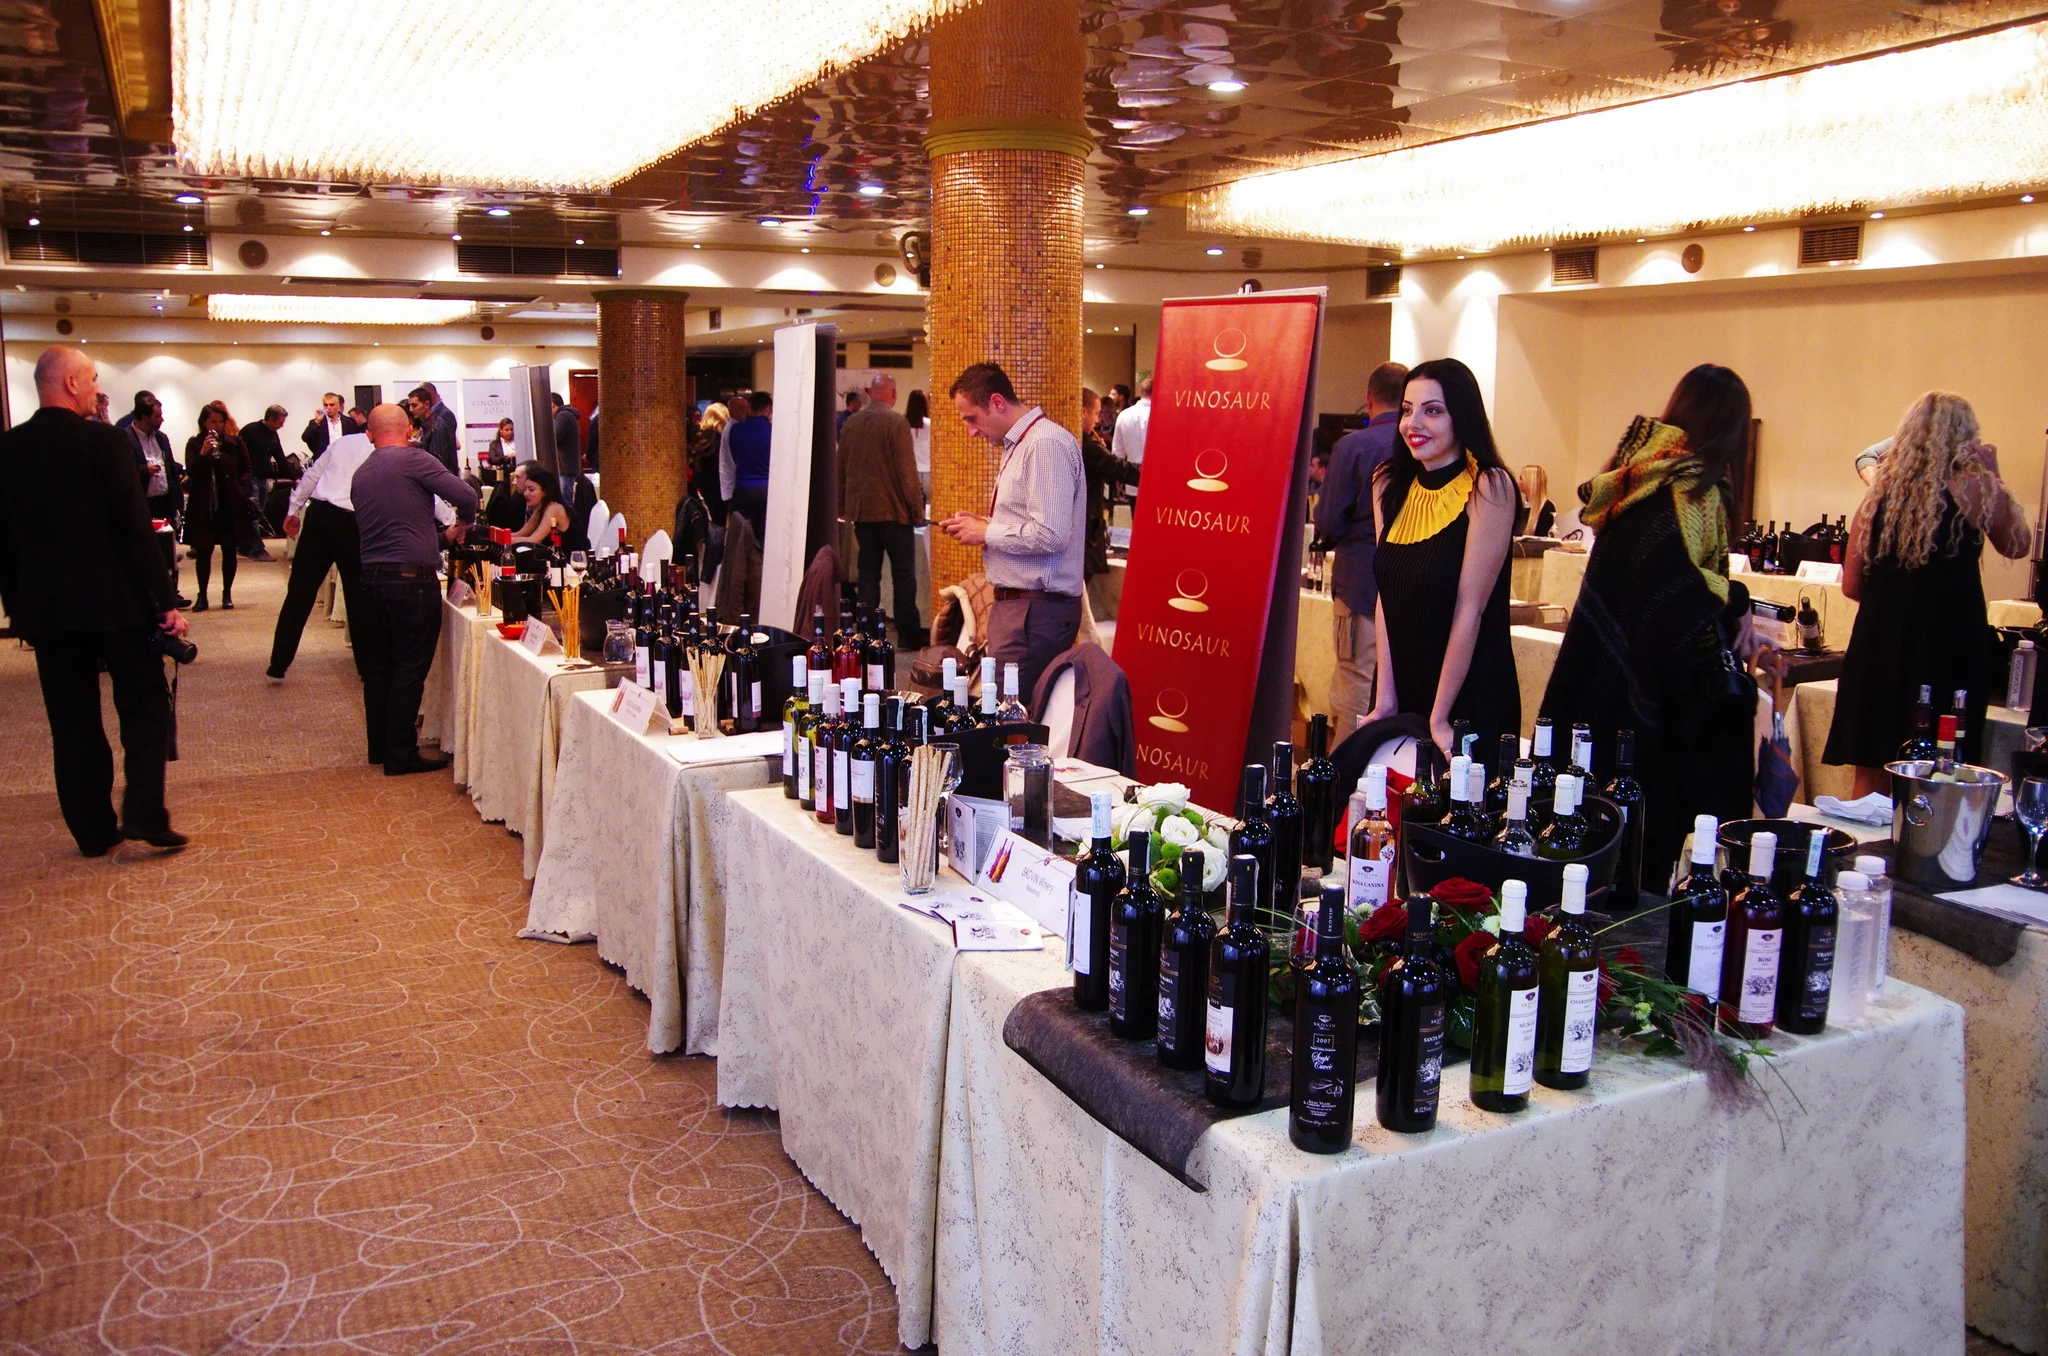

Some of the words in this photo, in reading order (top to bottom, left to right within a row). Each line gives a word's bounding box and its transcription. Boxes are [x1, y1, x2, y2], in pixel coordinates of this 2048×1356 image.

[470, 399, 510, 407] VINOSAU
[1174, 389, 1271, 411] VINOSAUR
[1156, 506, 1251, 535] VINOSAUR
[1137, 623, 1230, 659] VINOSAUR
[1136, 743, 1210, 781] NOSAUR
[1021, 866, 1040, 884] SKOVIN
[1038, 876, 1054, 896] Winery
